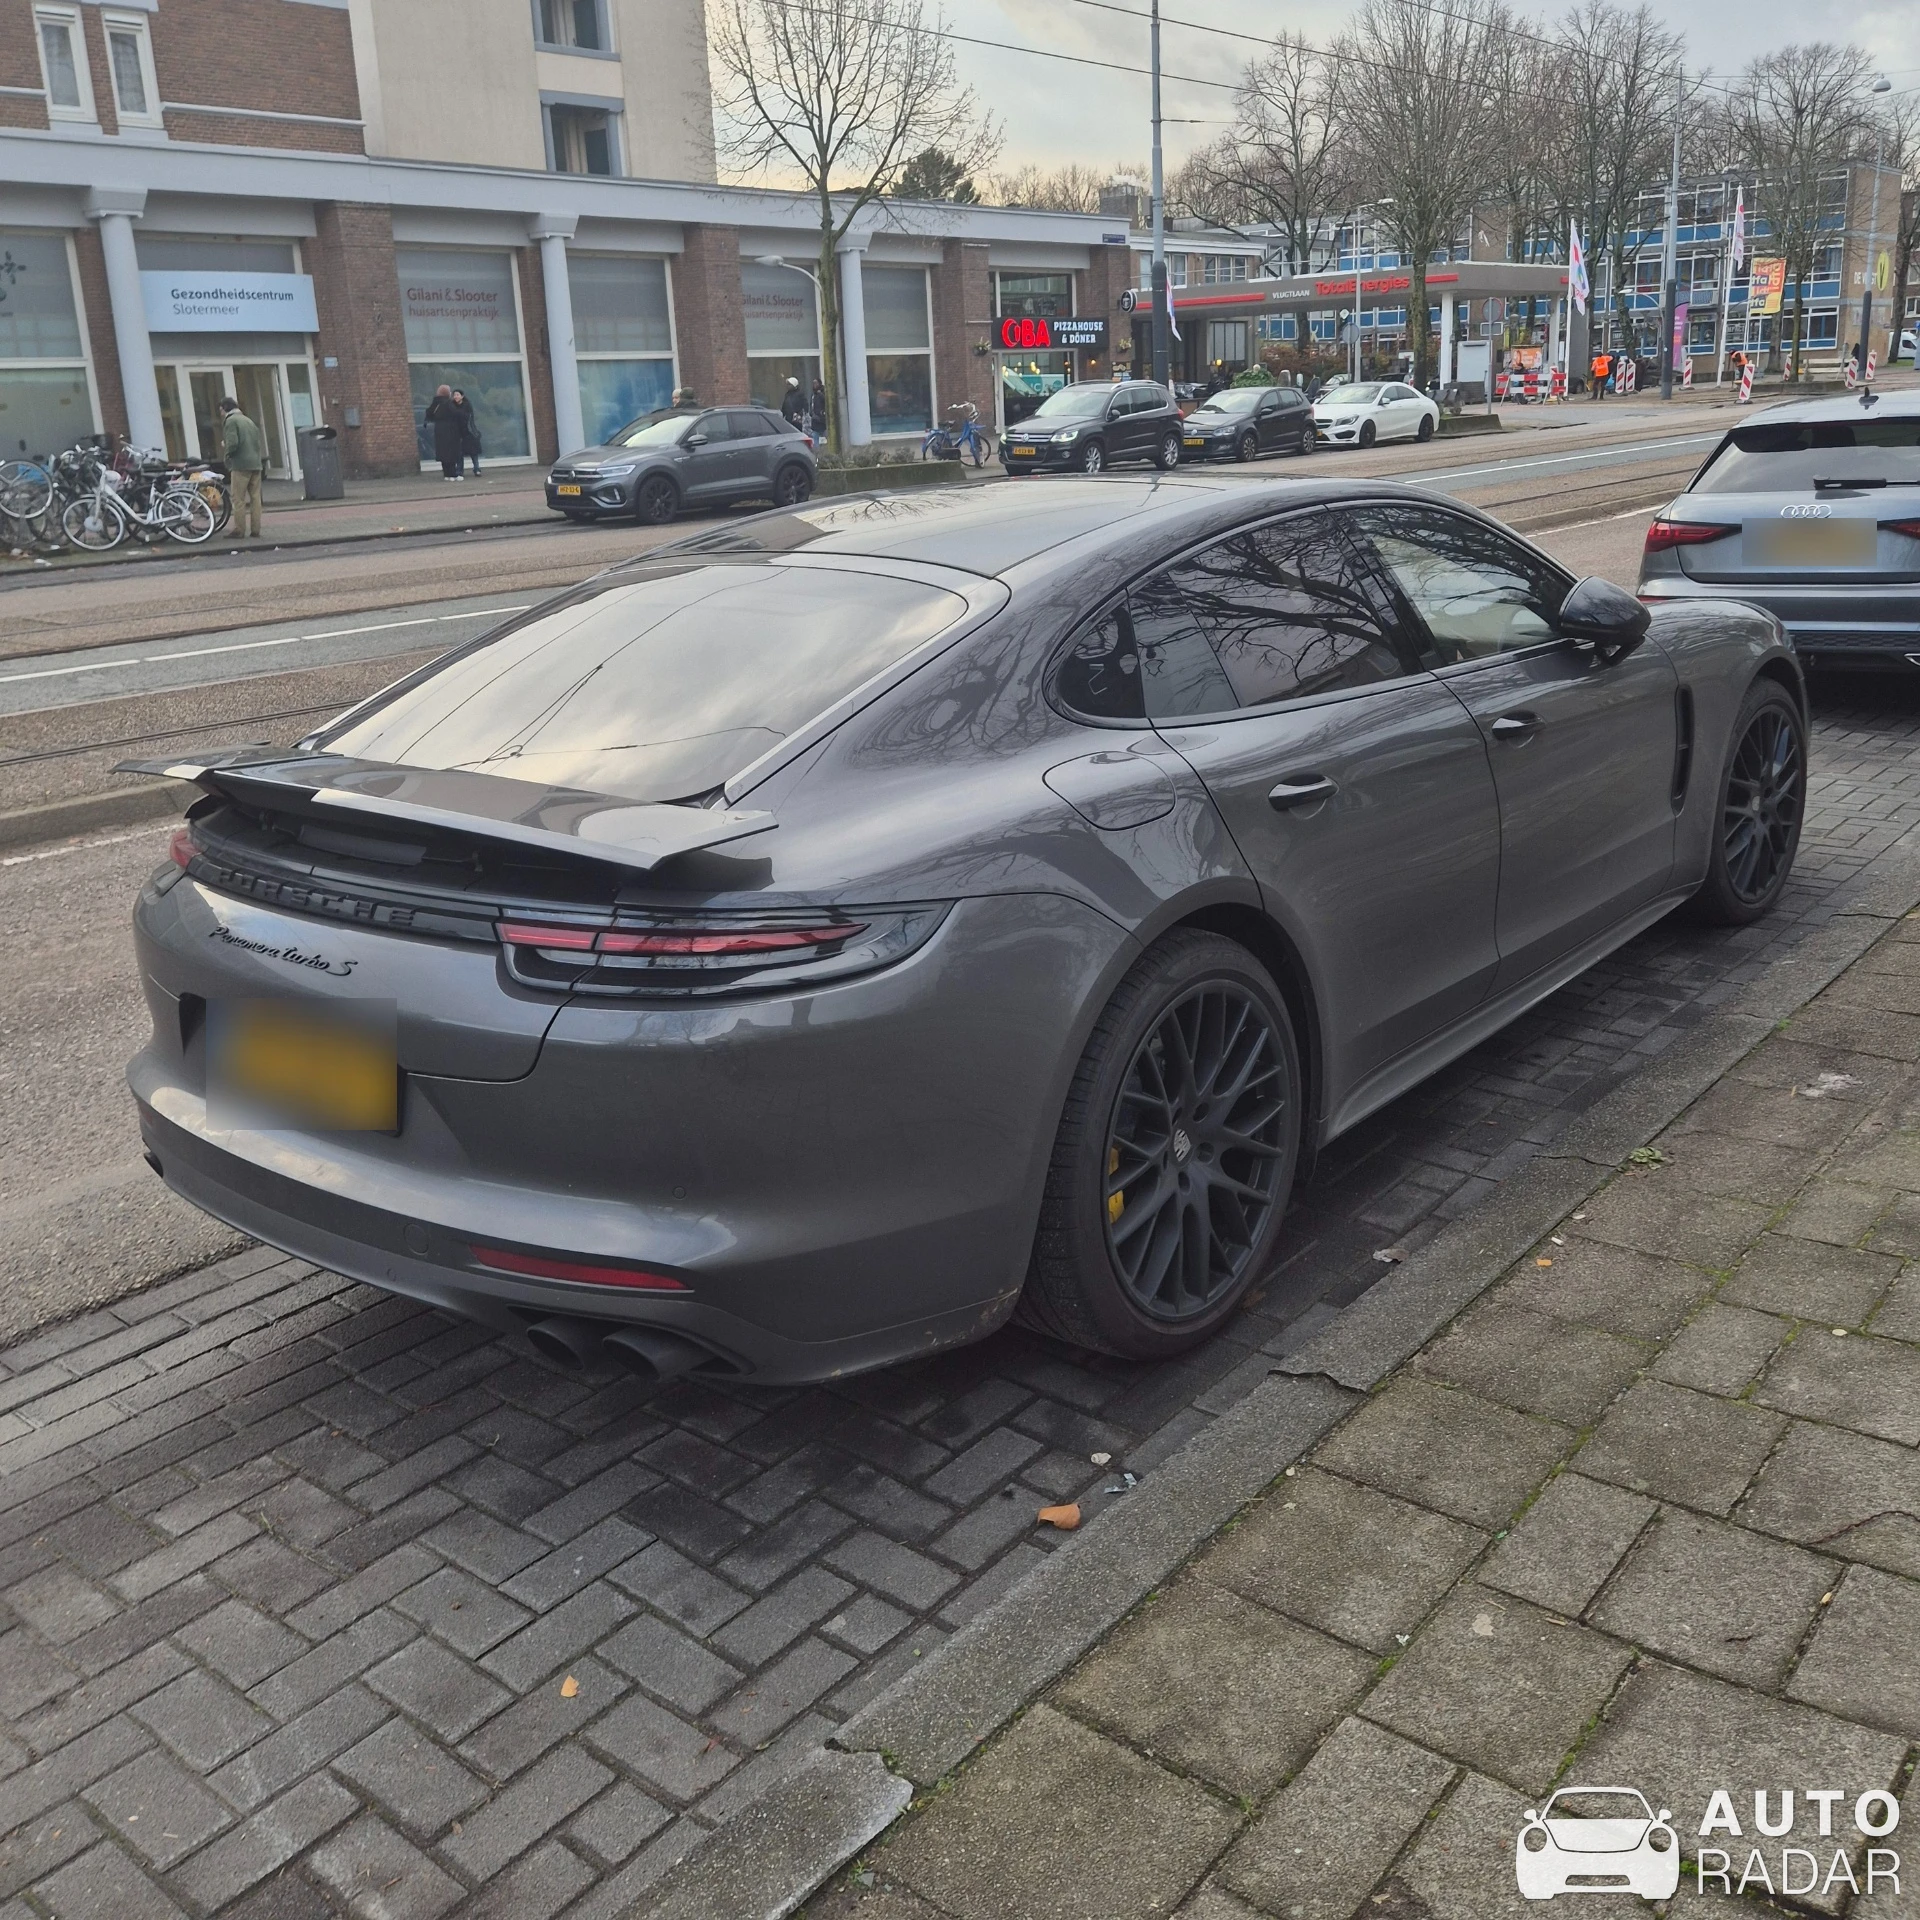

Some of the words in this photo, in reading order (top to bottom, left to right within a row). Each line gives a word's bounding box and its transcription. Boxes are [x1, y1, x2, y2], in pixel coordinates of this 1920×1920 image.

[1272, 290, 1310, 299] VLUGTLAAN
[1315, 275, 1411, 295] TotalEnergies
[171, 288, 294, 301] Gezondheidscentrum
[407, 287, 443, 301] Gilani
[454, 288, 498, 302] Slooter
[772, 294, 804, 306] Slooter
[172, 303, 240, 315] Slotermeer
[409, 305, 500, 320] huisartsenpraktijk
[745, 309, 804, 321] uisartsenpraktijk
[1053, 321, 1104, 332] PIZZAHOUSE
[1061, 334, 1068, 344] &
[1069, 332, 1097, 344] DÖNER
[218, 866, 415, 928] PORSCHE
[208, 925, 280, 960] Panamera
[325, 960, 359, 977] S
